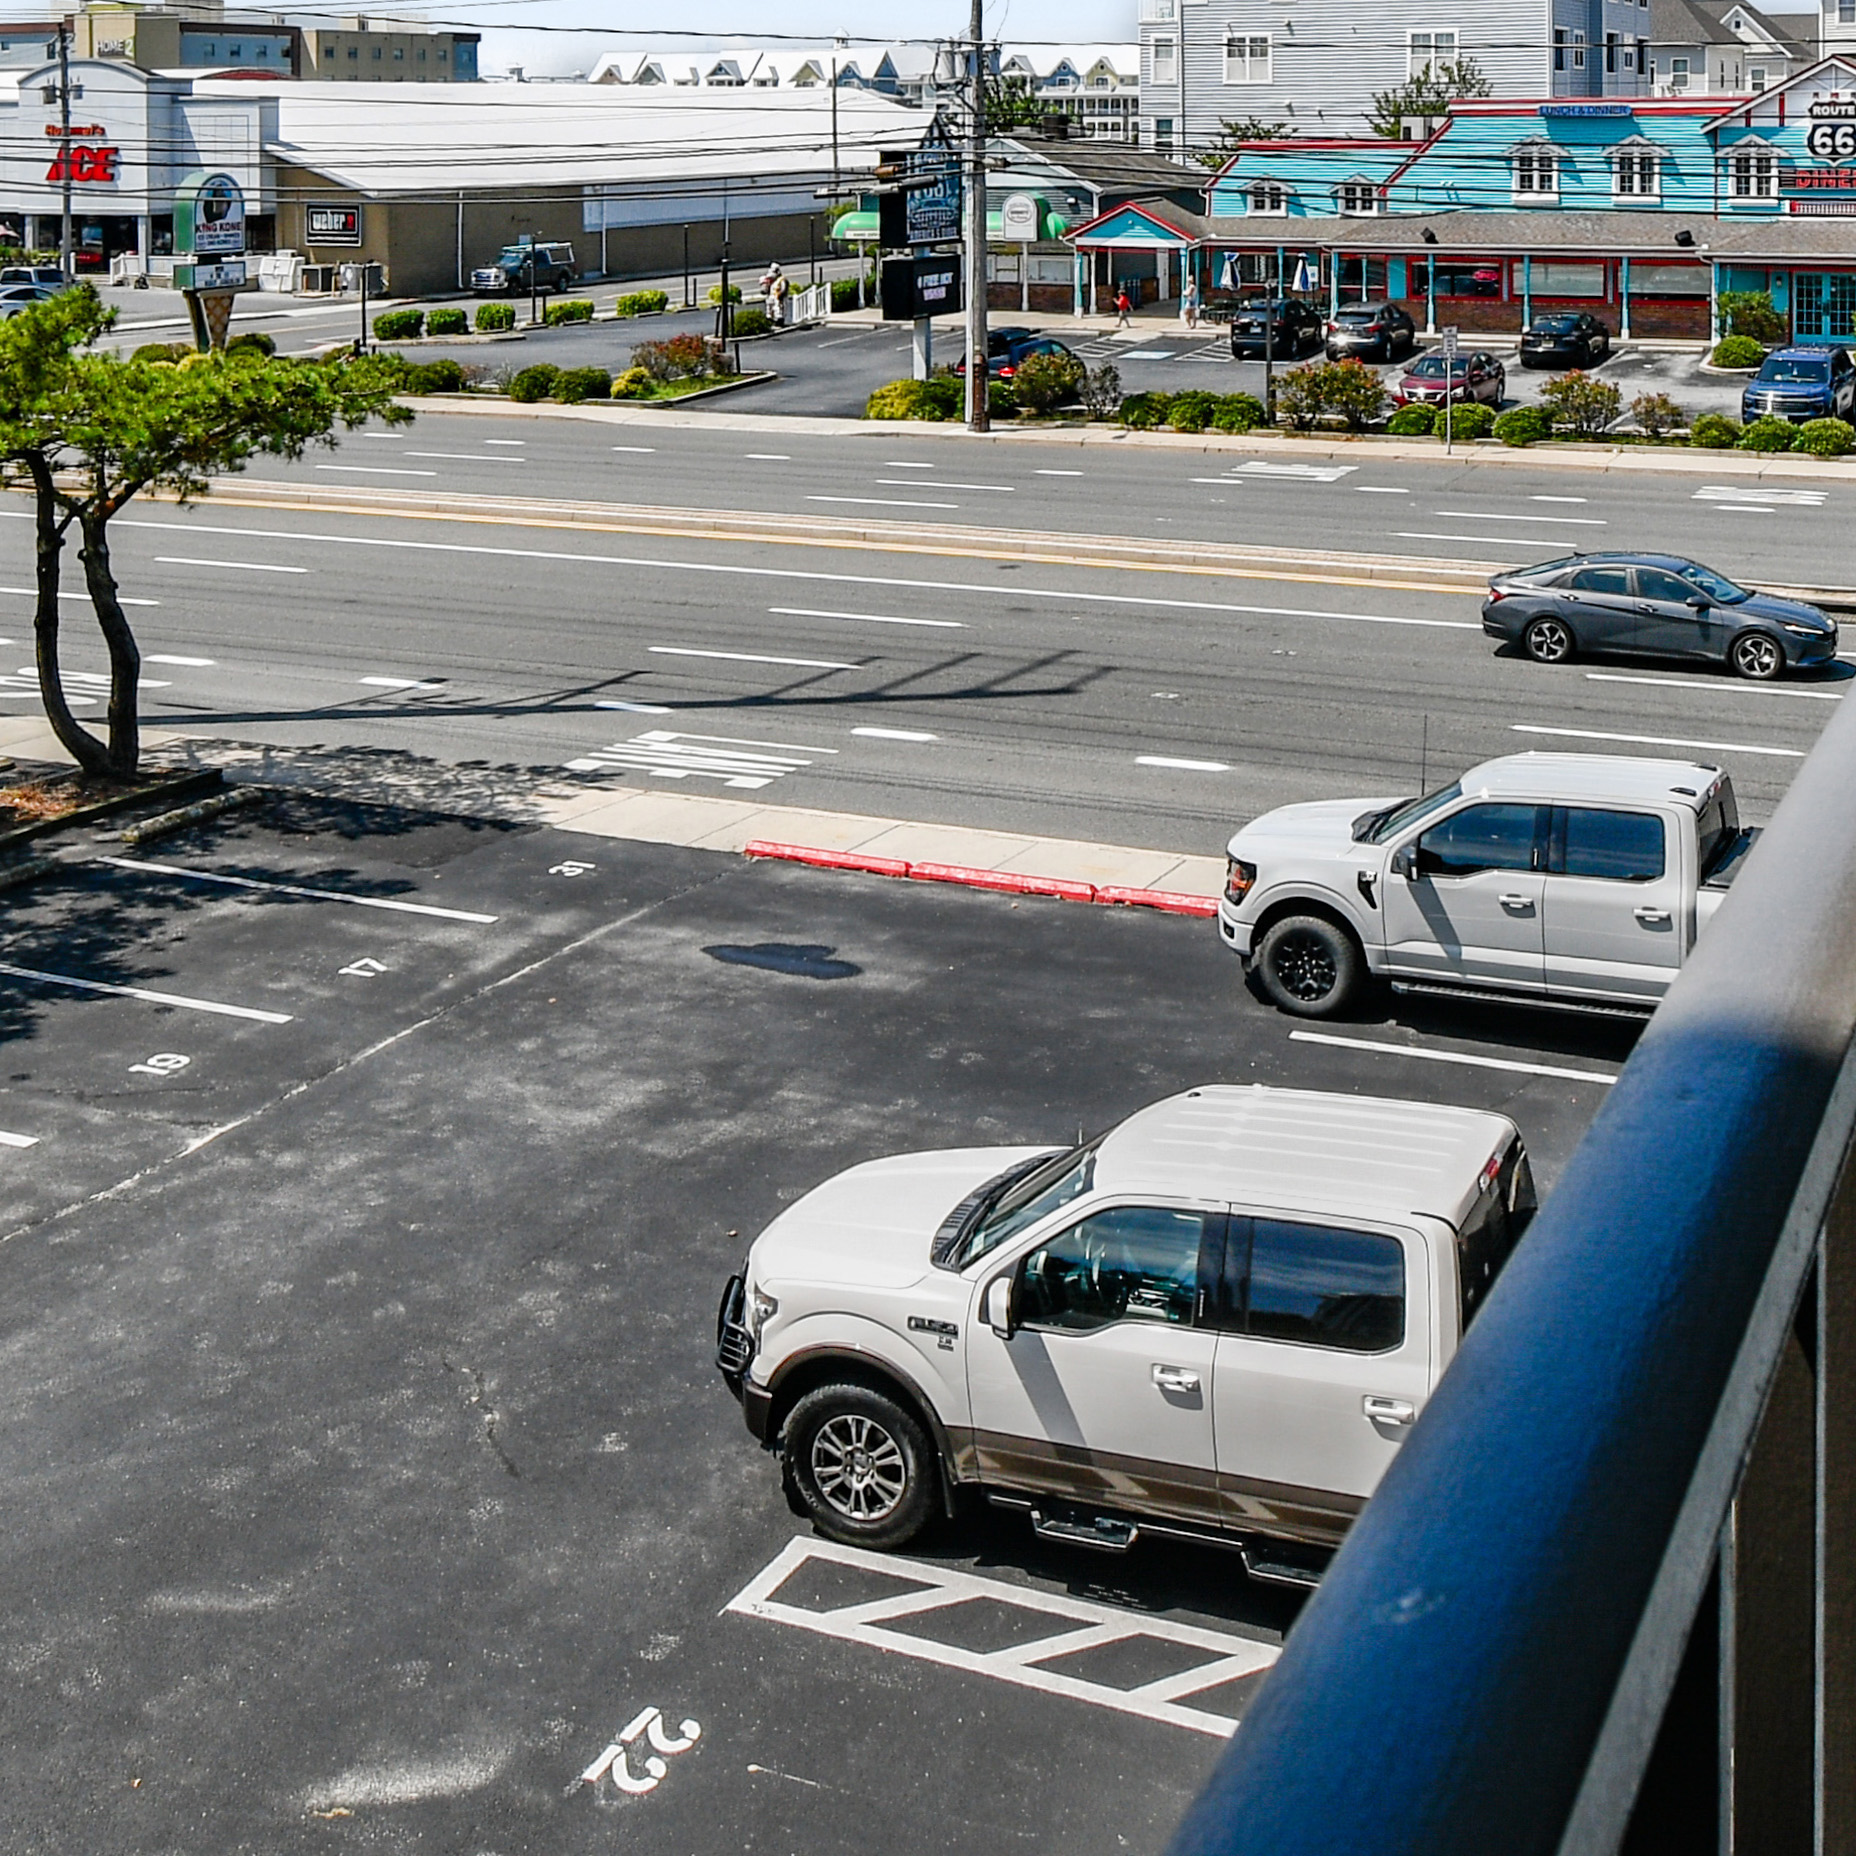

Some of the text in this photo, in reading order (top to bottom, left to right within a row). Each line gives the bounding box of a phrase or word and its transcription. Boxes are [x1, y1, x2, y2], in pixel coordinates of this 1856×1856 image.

[1813, 106, 1855, 115] ROUTE
[1814, 126, 1854, 155] 66
[46, 146, 118, 181] ACE
[313, 210, 346, 230] weber
[338, 957, 388, 977] 17
[128, 1053, 191, 1076] 19
[581, 1706, 702, 1792] 22
